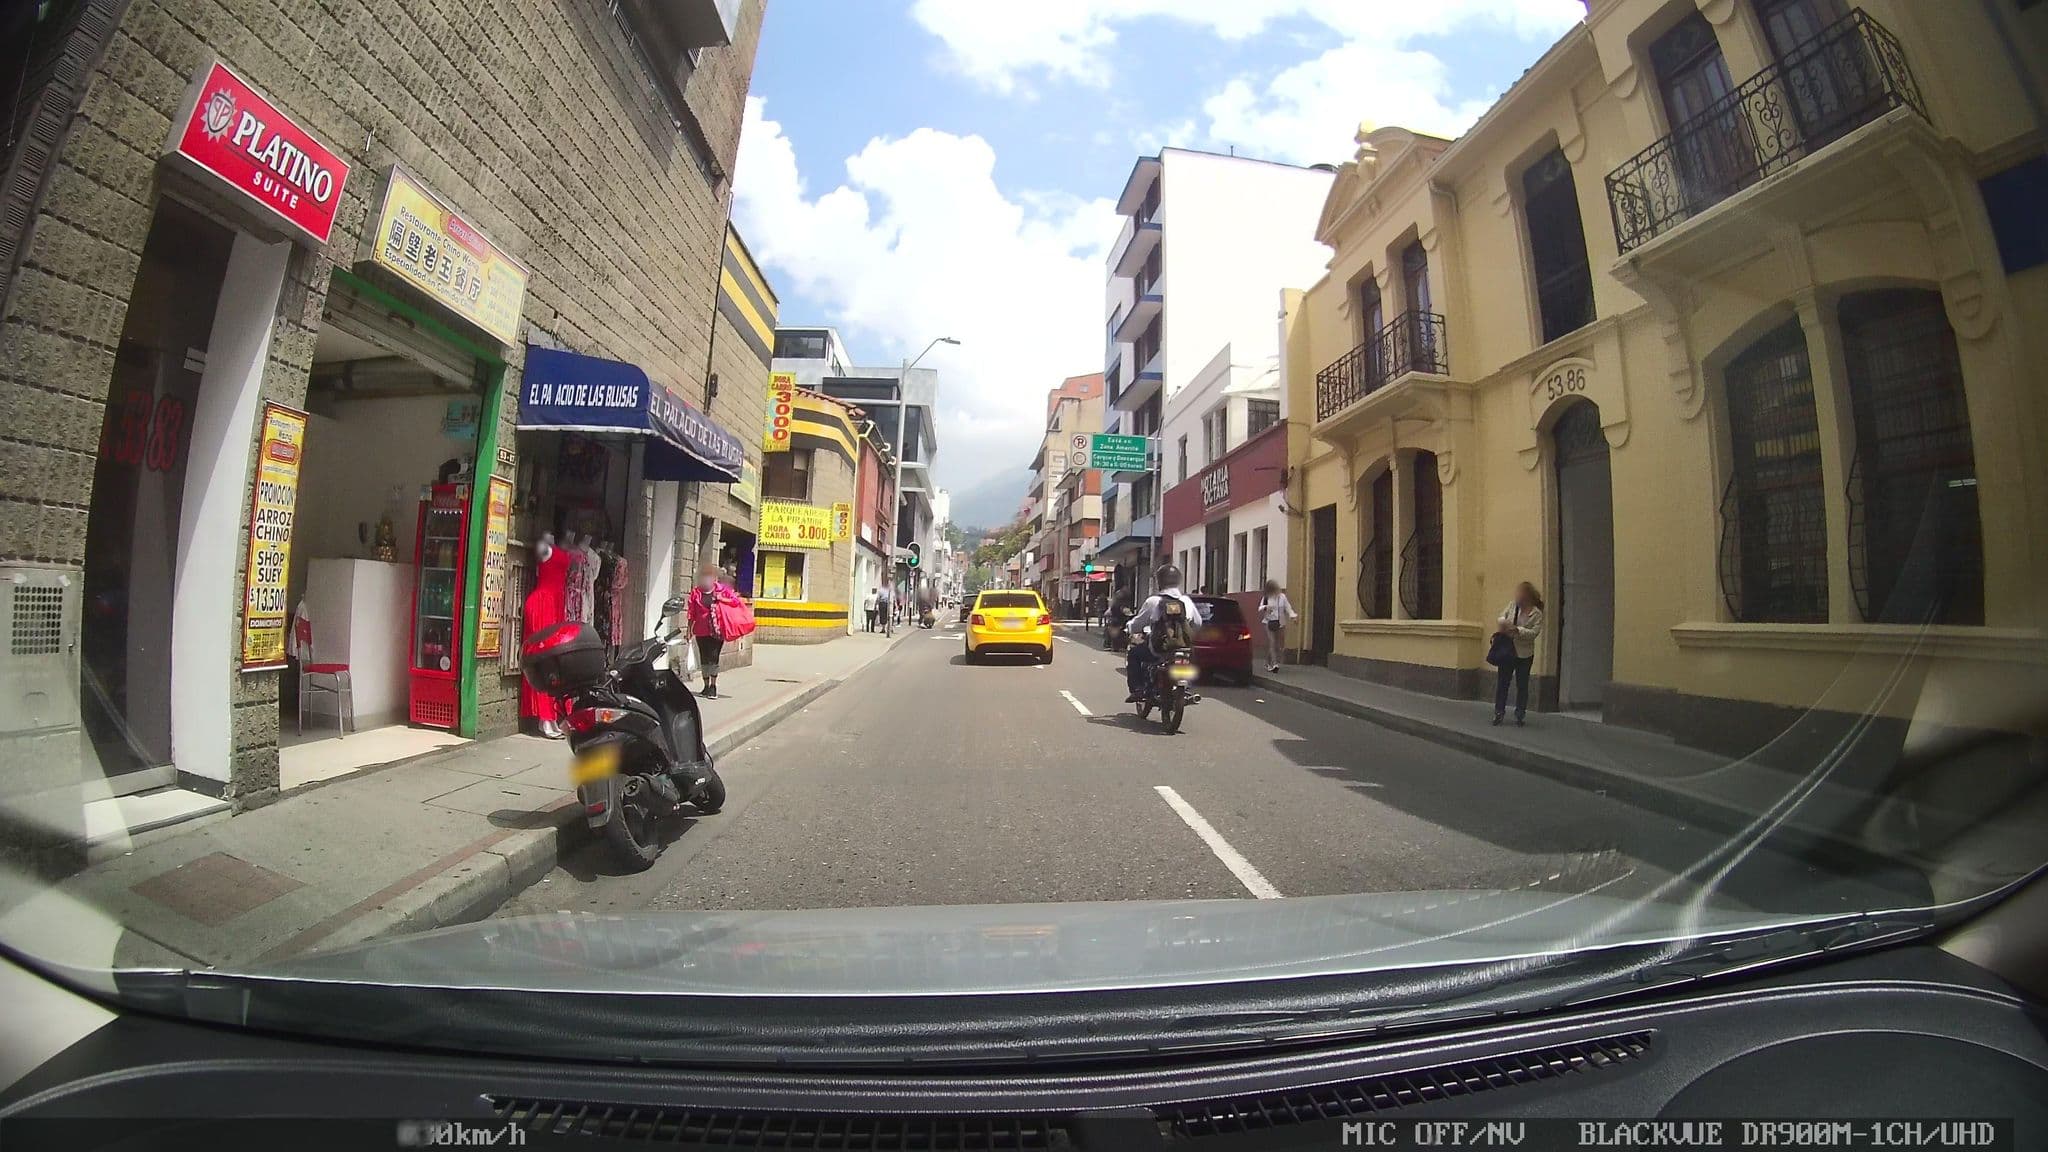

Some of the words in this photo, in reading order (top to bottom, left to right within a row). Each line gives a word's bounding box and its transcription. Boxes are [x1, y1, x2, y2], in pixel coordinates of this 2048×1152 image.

[231, 110, 333, 203] PLATINO
[253, 171, 299, 210] SUITE
[400, 206, 441, 243] Restaurante
[442, 238, 461, 257] Chino
[384, 247, 426, 282] Especialidad
[1548, 375, 1563, 401] 53
[1567, 368, 1585, 392] 86
[529, 383, 541, 405] EL
[575, 384, 588, 407] DE
[587, 384, 605, 407] LAS
[605, 385, 640, 408] BLUSAS
[650, 393, 661, 418] EL
[663, 400, 696, 437] PALACIO
[697, 424, 708, 446] DE
[708, 430, 721, 453] LAS
[772, 391, 792, 441] 3000
[256, 508, 293, 526] ARROZ
[771, 514, 783, 523] LA
[256, 525, 290, 542] CHINO
[764, 531, 791, 540] CARRO
[767, 524, 788, 532] HORA
[798, 524, 827, 541] 3.000
[257, 550, 285, 567] SHOP
[258, 567, 282, 583] SUEY
